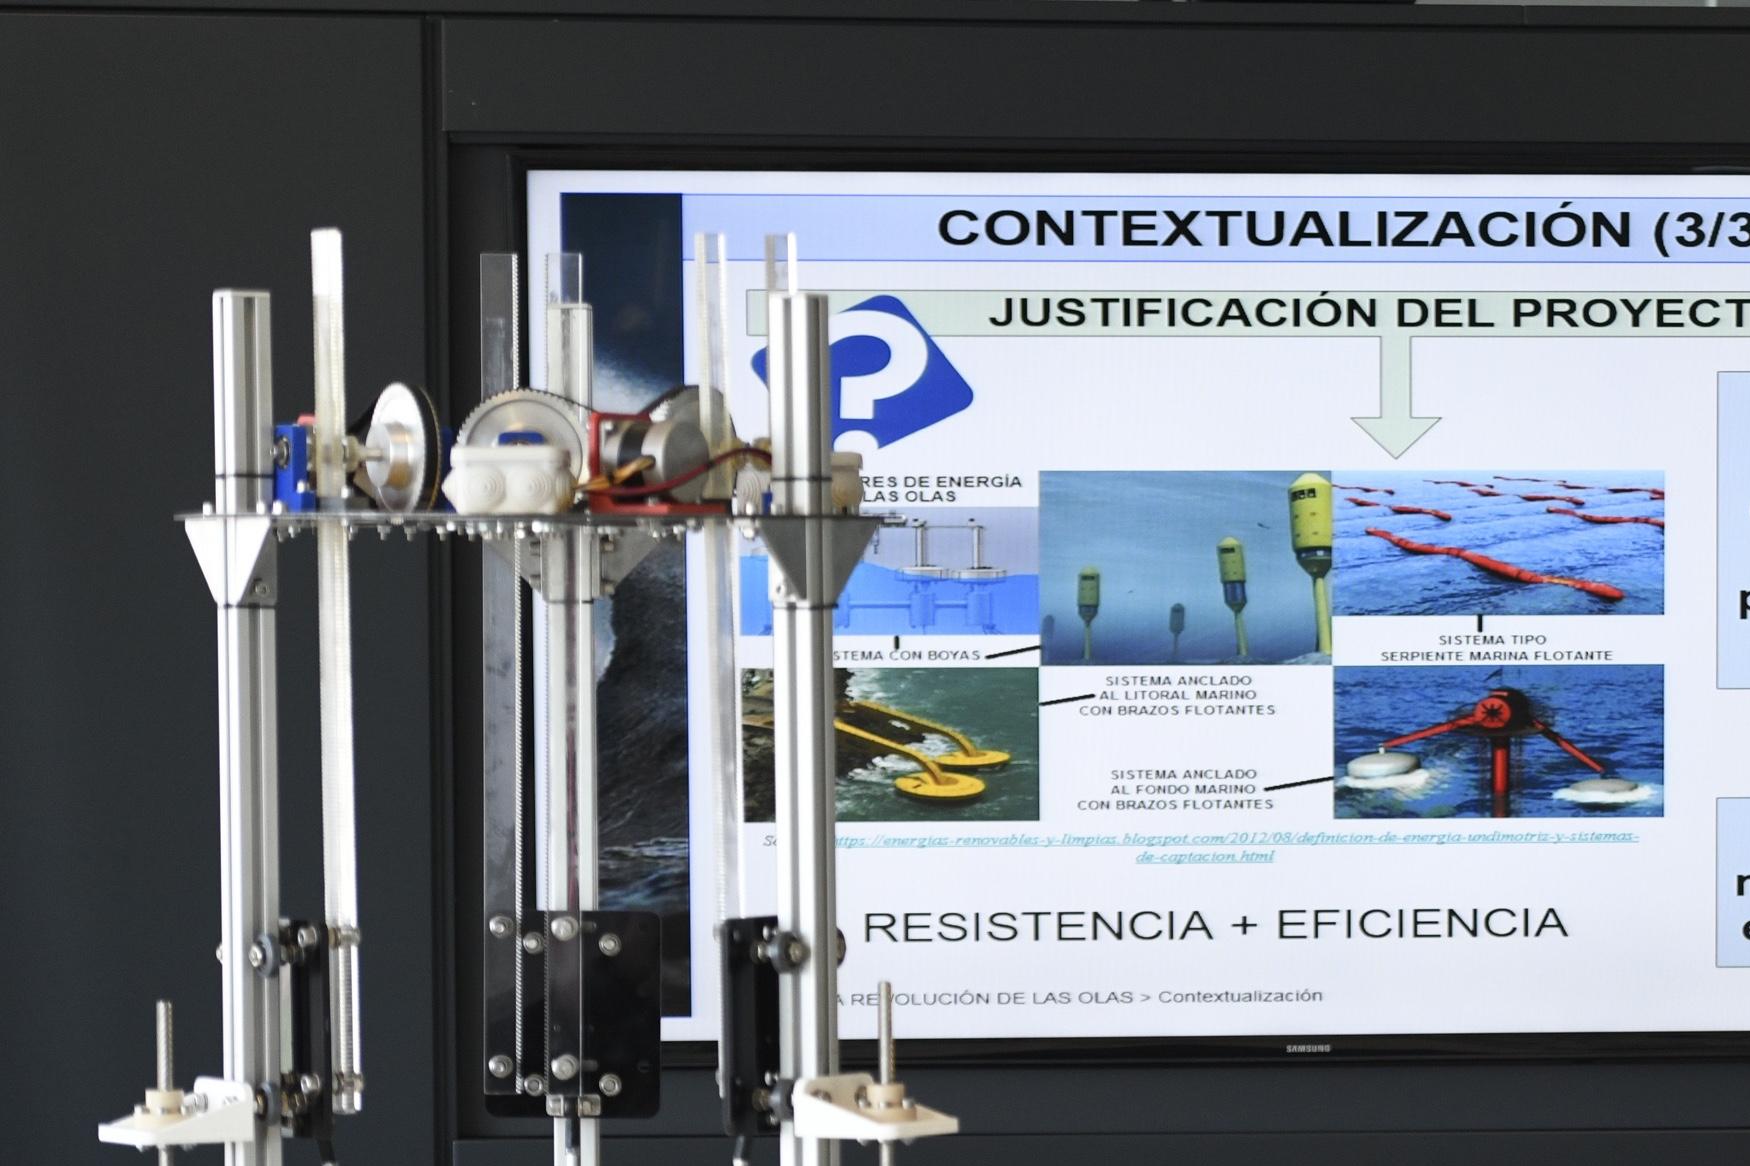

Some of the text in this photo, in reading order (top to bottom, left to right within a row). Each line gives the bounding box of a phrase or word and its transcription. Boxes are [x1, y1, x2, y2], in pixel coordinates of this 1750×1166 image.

[939, 202, 1630, 248] CONTEXTUALIZACIÓN
[989, 290, 1376, 329] JUSTIFICACIÓN
[1398, 299, 1495, 328] DEL
[904, 476, 930, 488] DE
[936, 473, 1022, 488] ENERGÍA
[863, 490, 956, 503] LAS OLAS
[1440, 635, 1547, 646] SISTEMA TIPO
[889, 650, 922, 661] CON
[928, 650, 980, 661] BOYAS
[1382, 651, 1612, 662] SERPIENTE MARINA FLOTANTE
[1106, 676, 1252, 686] SISTEMA ANCLADO
[1100, 690, 1257, 701] AL LITORAL MARINO
[1080, 705, 1276, 716] CON BRAZOS FLOTANTES
[1112, 769, 1257, 780] SISTEMA ANCLADO
[1111, 784, 1256, 795] AL FONDO MARINO
[1077, 799, 1274, 811] CON BRAZOS FLOTANTES
[1136, 850, 1276, 865] de-captacion.html
[865, 908, 1569, 943] RESISTENCIA + EFICIENCIA
[997, 992, 1025, 1005] DE
[1033, 992, 1072, 1005] LAS
[1078, 991, 1134, 1005] OLAS
[1141, 994, 1151, 1002] >
[1158, 989, 1323, 1004] Contextualización
[1286, 1044, 1331, 1053] SAMSUNG
